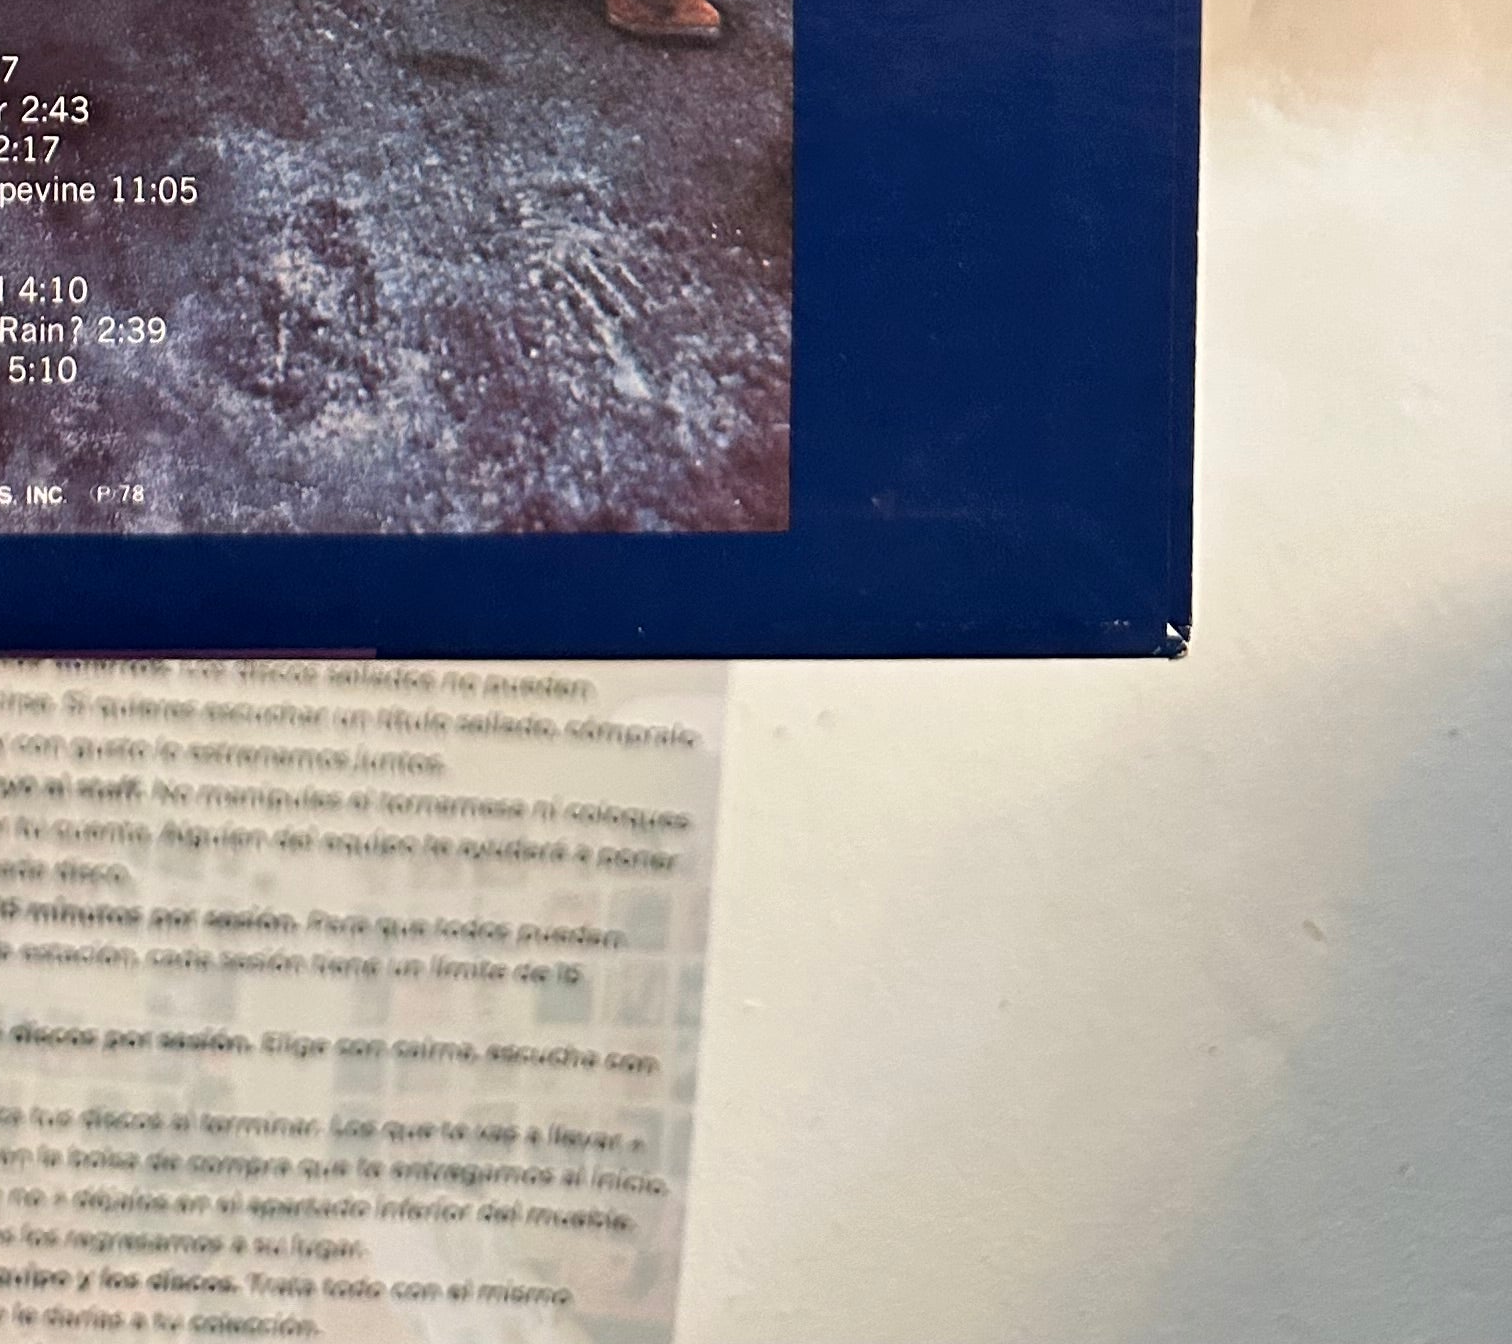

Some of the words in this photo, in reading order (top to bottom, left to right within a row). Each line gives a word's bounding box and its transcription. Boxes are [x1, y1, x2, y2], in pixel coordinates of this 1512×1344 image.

[21, 95, 89, 124] 2:43
[112, 175, 198, 204] 11:05
[18, 276, 88, 304] 4:10
[98, 316, 166, 344] 2:39
[8, 355, 77, 384] 5:10
